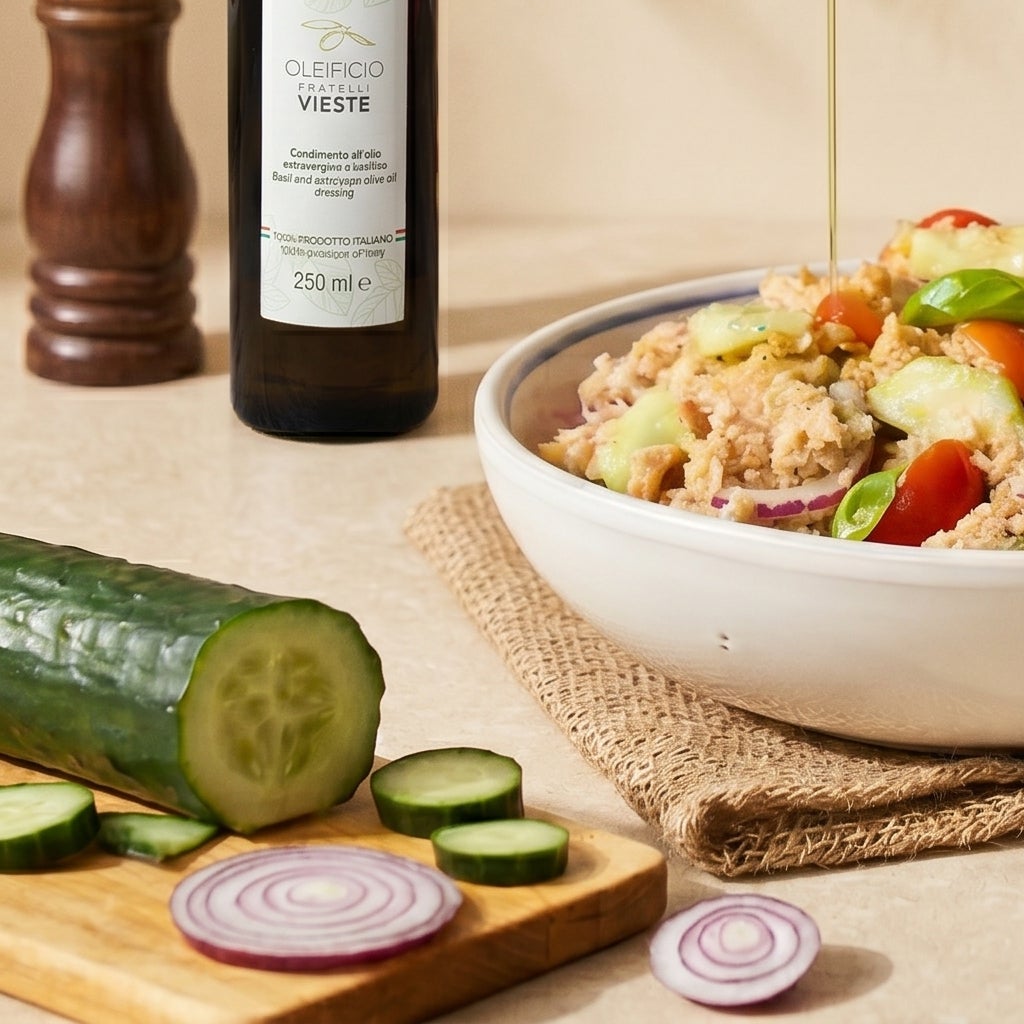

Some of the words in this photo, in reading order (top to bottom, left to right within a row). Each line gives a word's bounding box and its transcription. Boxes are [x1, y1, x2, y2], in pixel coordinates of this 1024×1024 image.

[285, 59, 384, 79] OLEIFICIO
[298, 82, 370, 93] FRATELLI
[297, 94, 370, 113] VIESTE
[290, 148, 349, 160] Condimento
[272, 171, 293, 183] Basil
[294, 175, 313, 184] and
[363, 173, 385, 185] olive
[386, 172, 397, 183] oil
[314, 187, 355, 200] dressing
[352, 234, 394, 245] ITALIANO
[294, 271, 326, 291] 250
[331, 274, 352, 292] ml
